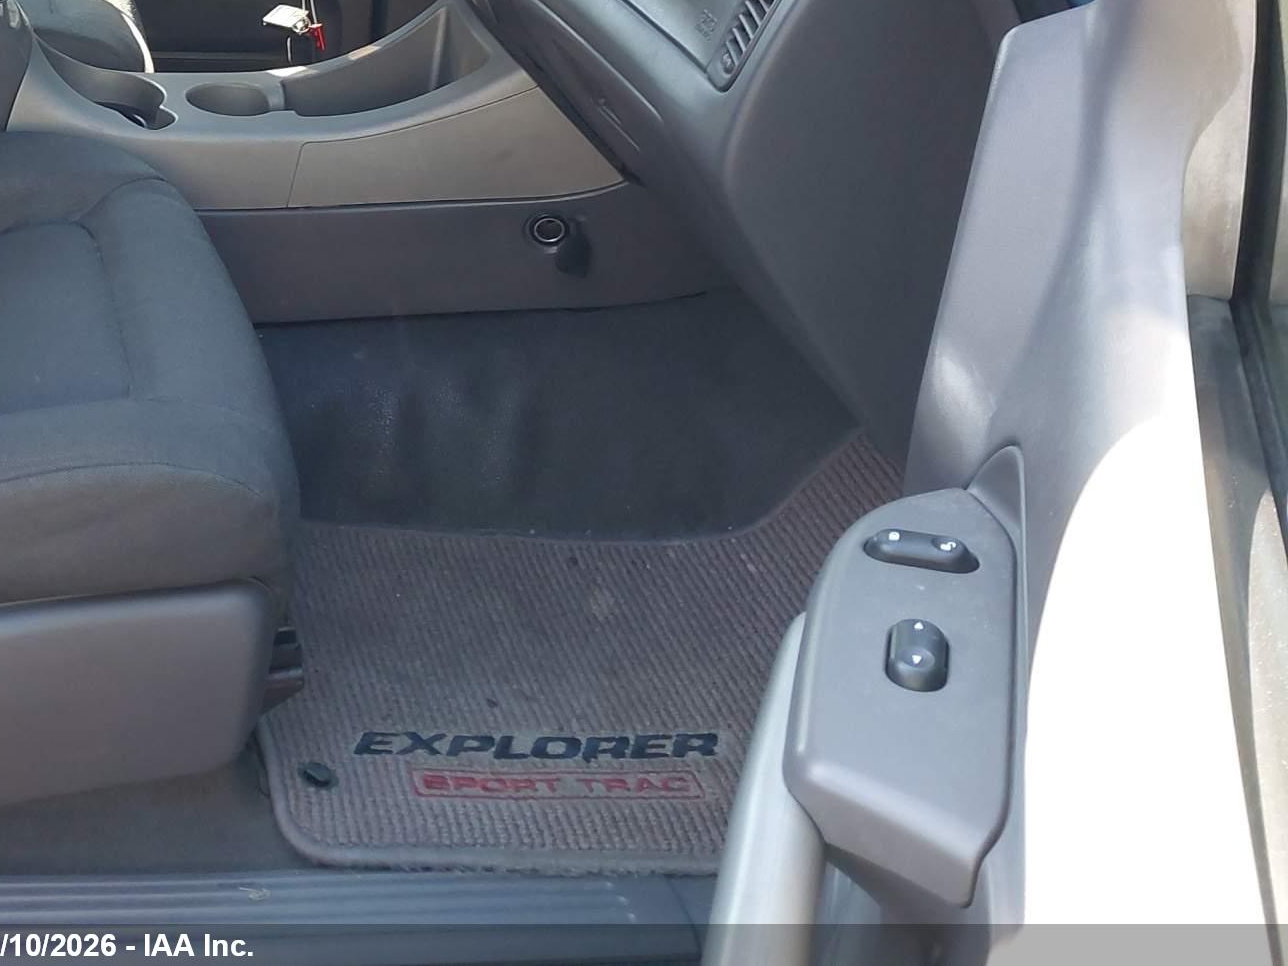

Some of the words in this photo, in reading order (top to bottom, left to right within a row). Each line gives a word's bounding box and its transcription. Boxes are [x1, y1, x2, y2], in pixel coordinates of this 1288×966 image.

[354, 731, 718, 763] EXPLORER
[423, 774, 560, 793] SPORT
[575, 777, 687, 793] TRAC
